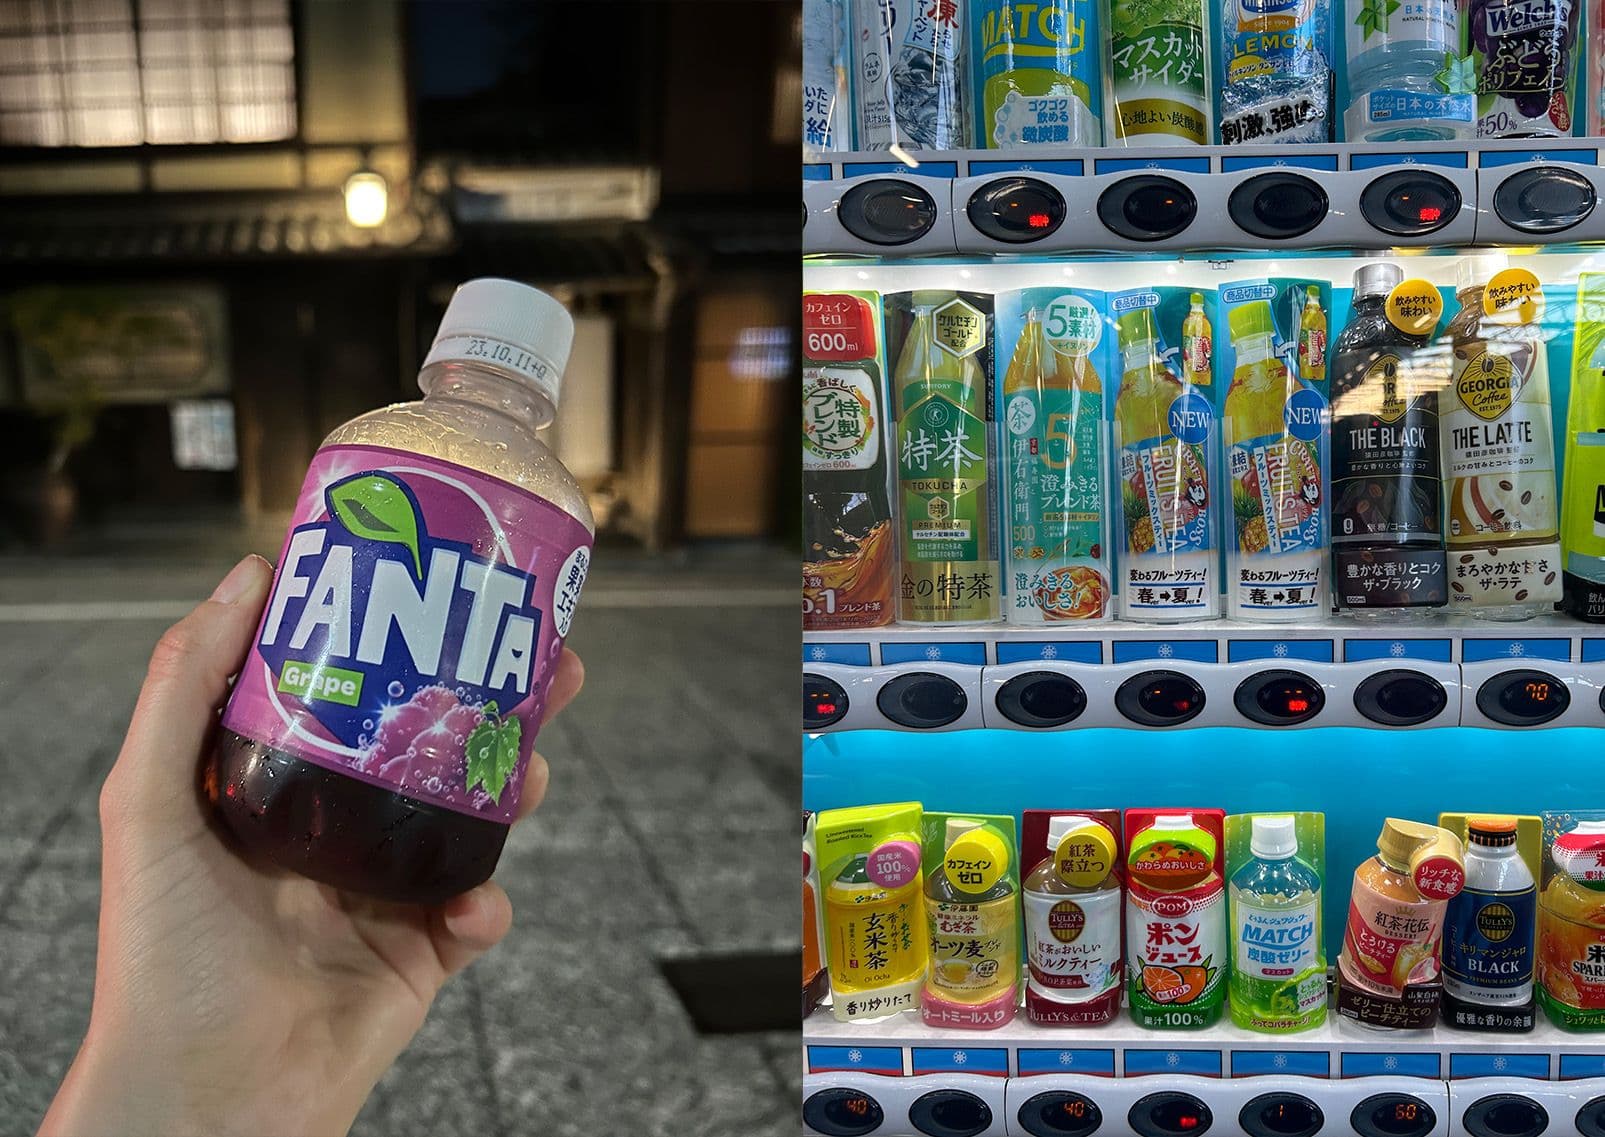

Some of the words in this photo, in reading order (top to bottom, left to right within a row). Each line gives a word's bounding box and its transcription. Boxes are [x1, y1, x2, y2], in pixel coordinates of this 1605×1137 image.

[1488, 2, 1568, 33] Welch's
[982, 3, 1085, 50] MATCH
[1112, 31, 1202, 68] マスカット
[1234, 34, 1313, 57] LEMON
[1487, 38, 1562, 72] ぶどう
[1129, 58, 1203, 88] サイダー
[1029, 99, 1068, 111] ゴクゴク
[1396, 96, 1471, 113] 日本の天然水
[1037, 111, 1069, 124] 飲める
[1485, 112, 1517, 136] 50%
[1022, 124, 1069, 143] 微炭酸
[1225, 288, 1274, 301] 商品切替中
[1489, 283, 1535, 299] 飲みやすい
[806, 302, 851, 312] カフェイン
[1114, 295, 1158, 308] 商品切替中
[1395, 296, 1436, 306] 飲みやすい
[1069, 307, 1095, 319] 厳選!
[1400, 306, 1432, 317] 味わい
[819, 315, 842, 325] ゼロ
[938, 315, 977, 328] ケルセチン
[1046, 304, 1067, 338] 5
[943, 330, 973, 338] ゴールド
[1068, 320, 1096, 339] 素材
[808, 333, 859, 351] 600ml
[951, 340, 967, 348] 配合
[1460, 376, 1519, 394] GEORGIA
[1472, 391, 1508, 406] Coffee
[811, 392, 838, 446] ブレンド
[835, 398, 861, 437] 特製
[1011, 402, 1031, 430] 茶
[1172, 412, 1209, 428] NEW
[1287, 408, 1327, 424] NEW
[1349, 428, 1378, 450] THE
[1380, 427, 1426, 449] BLACK
[1452, 426, 1480, 450] THE
[1484, 421, 1533, 446] LATTE
[902, 428, 983, 472] 特茶
[912, 482, 968, 490] TOKUCHA
[1013, 439, 1031, 521] 伊右衛門
[1040, 475, 1098, 492] 澄みきる
[1040, 494, 1101, 510] ブレンド茶
[1142, 455, 1163, 547] フルーツミックスティー
[1256, 453, 1277, 547] フルーツミックスティー
[1013, 525, 1036, 541] 500
[1189, 509, 1206, 546] BOSS
[1303, 508, 1320, 545] BOSS
[1130, 568, 1207, 581] 変わるフルーツティー!
[1240, 568, 1319, 582] 変わるフルーツティー!
[1347, 562, 1441, 578] 豊かな香りとコク
[1456, 560, 1548, 578] まろやかな甘さ
[901, 573, 993, 600] 金の特茶
[1015, 573, 1073, 591] 澄みきる
[1363, 577, 1422, 592] ザ・ブラック
[1479, 577, 1522, 591] ザ・ラテ
[840, 602, 881, 613] ブレンド茶
[1015, 593, 1082, 610] おいしさ!
[260, 527, 536, 695] FANTA
[284, 664, 357, 697] Grape
[1525, 684, 1548, 701] 70
[877, 854, 902, 862] 国産米
[1068, 844, 1096, 857] 紅茶
[876, 861, 911, 875] 100%
[947, 859, 992, 870] カフェイン
[1060, 858, 1105, 874] 際立つ
[885, 874, 901, 882] 使用
[957, 873, 983, 884] ゼロ
[1421, 866, 1461, 881] リッチな
[1419, 878, 1458, 894] 新食感
[1157, 902, 1188, 911] POM
[1051, 913, 1084, 922] TULLY'S
[1375, 911, 1429, 933] 紅茶花伝
[1480, 916, 1513, 926] TULLY'S
[940, 921, 977, 934] むぎ茶
[1147, 922, 1200, 946] ポン
[1242, 921, 1313, 944] MATCH
[1384, 930, 1417, 939] DESSERT
[863, 912, 889, 971] 玄米茶
[930, 936, 985, 959] オーツ麦
[1038, 943, 1102, 955] 紅茶がおいしい
[1360, 928, 1396, 954] とろける
[1145, 944, 1202, 964] ジュース
[1248, 947, 1310, 965] 炭酸ゼリー
[1460, 944, 1526, 958] キリマンジャロ
[1039, 954, 1103, 972] ミルクティー
[1467, 958, 1519, 974] BLACK
[846, 993, 912, 1016] 香り炒りたて
[1351, 996, 1431, 1017] ゼリー仕立ての
[922, 1010, 1006, 1024] オートミール入り
[1144, 1013, 1204, 1026] 果汁100%
[1360, 1009, 1420, 1024] ピーチティー
[1456, 1011, 1532, 1027] 優雅な香りの余韻
[847, 1098, 867, 1115] 40
[1064, 1101, 1085, 1117] 40
[1395, 1104, 1416, 1120] 60
